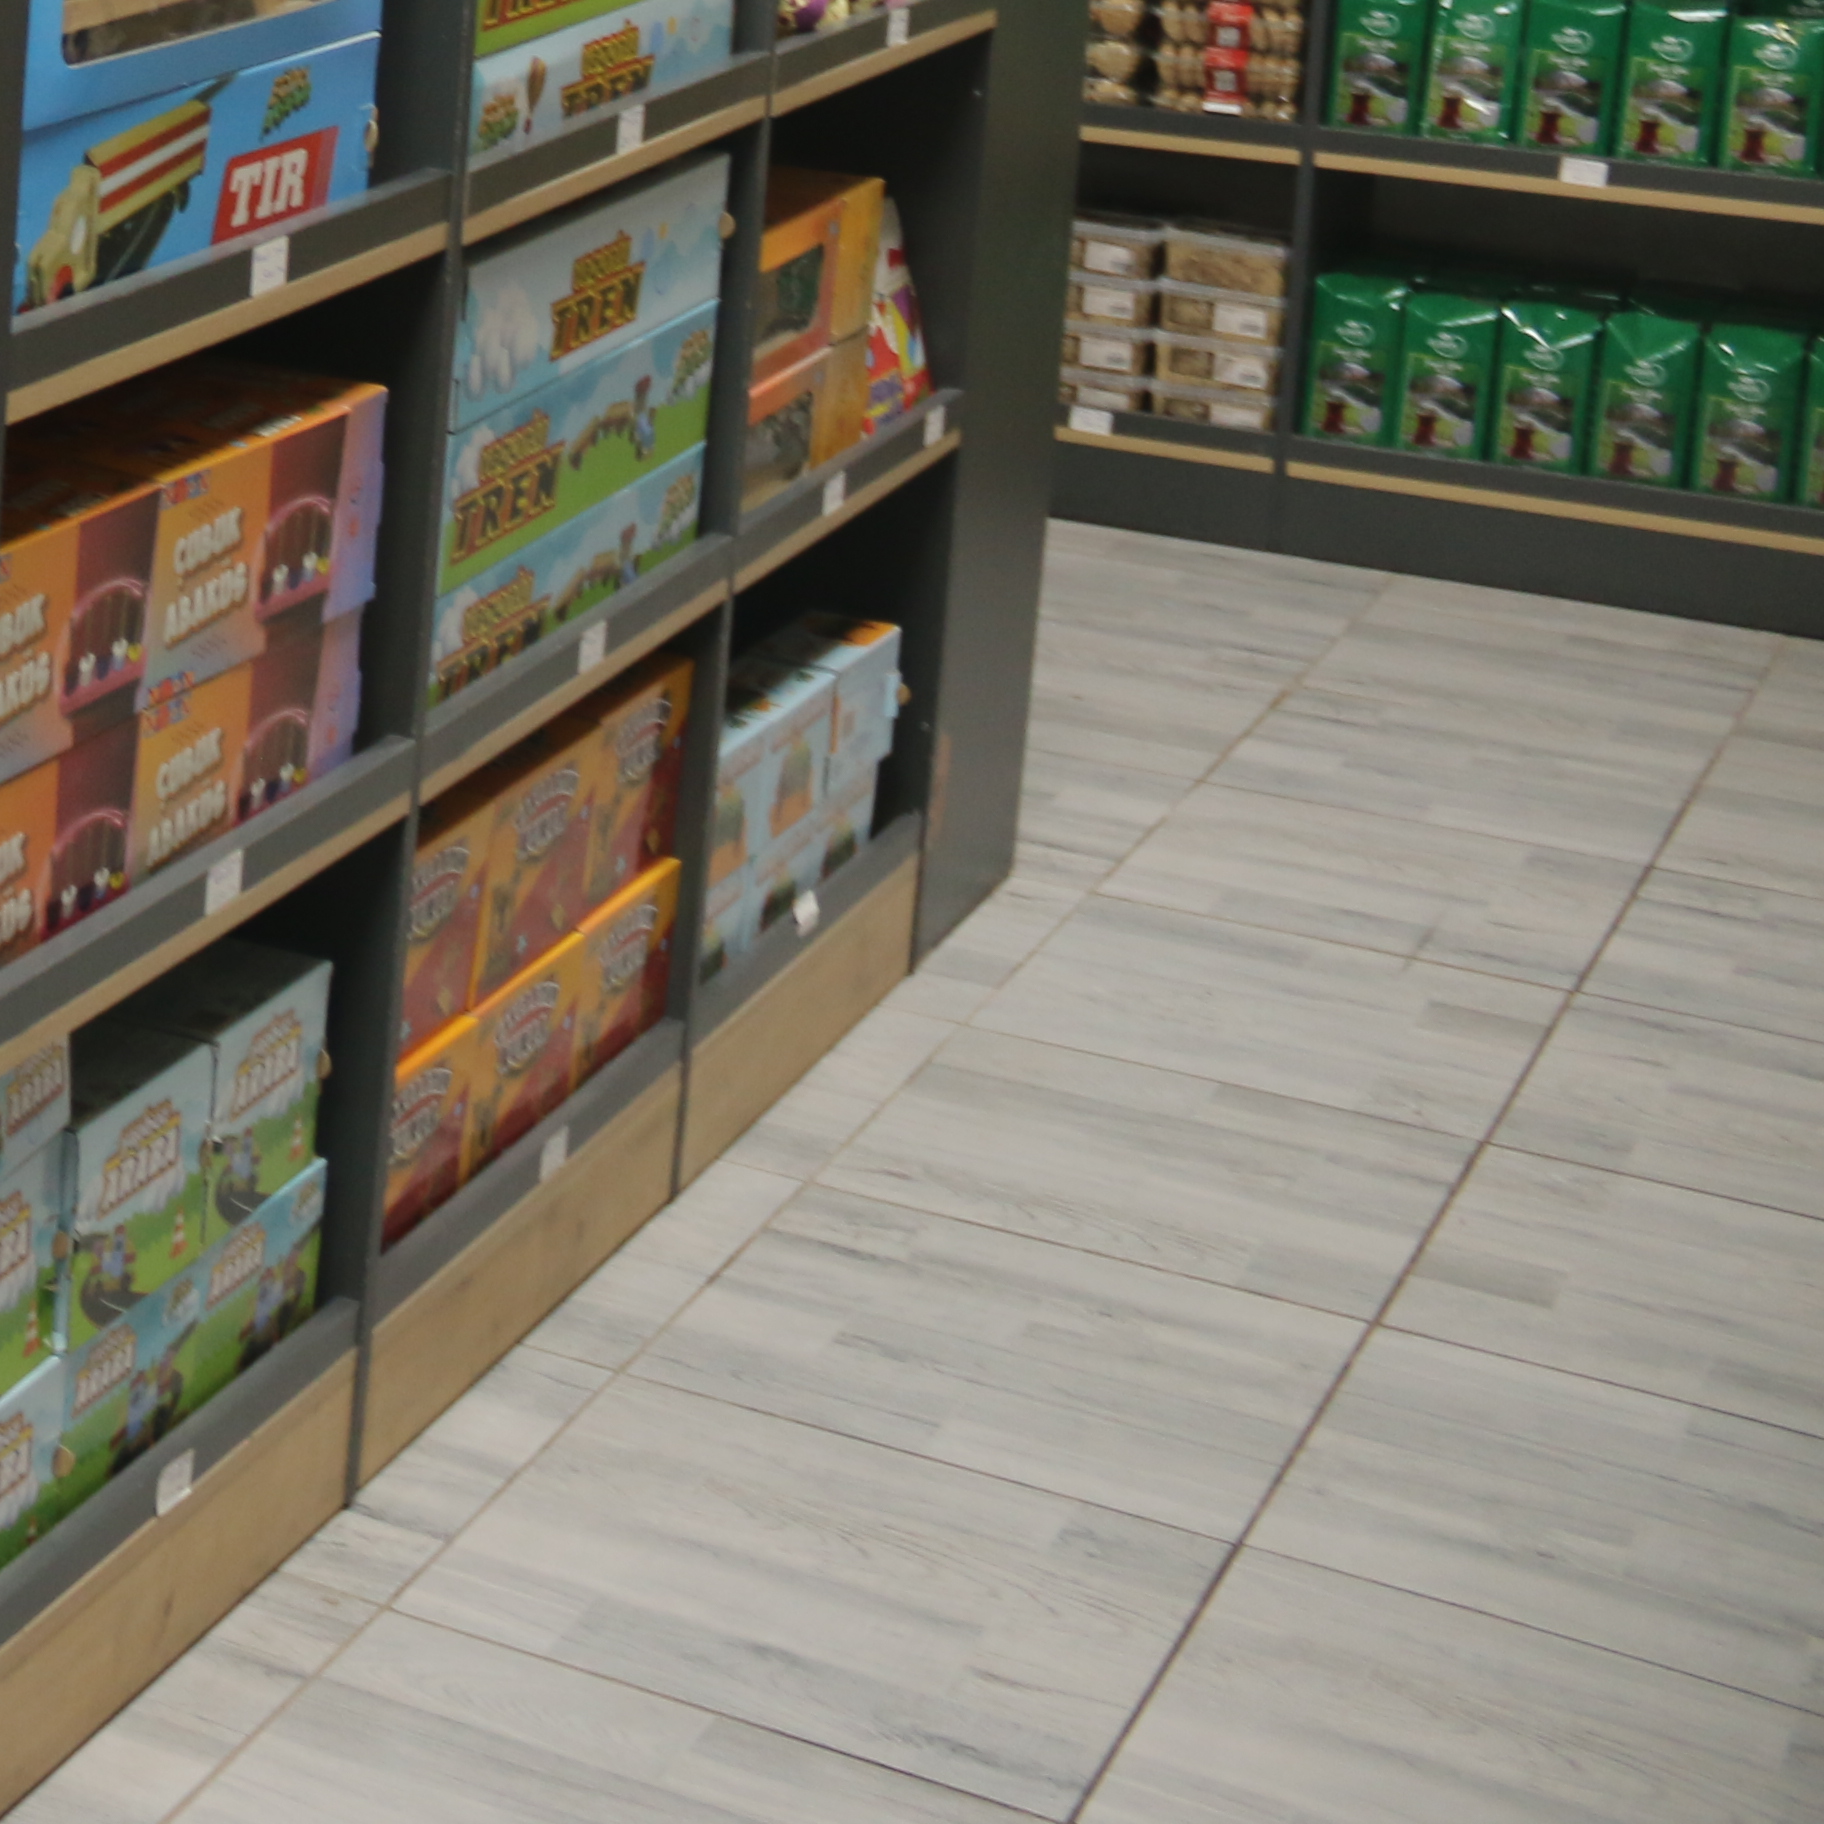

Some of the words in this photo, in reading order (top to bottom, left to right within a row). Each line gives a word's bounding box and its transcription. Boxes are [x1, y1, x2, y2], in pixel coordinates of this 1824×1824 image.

[228, 147, 308, 229] TIR
[550, 263, 646, 361] TREN
[451, 444, 564, 565] TREN
